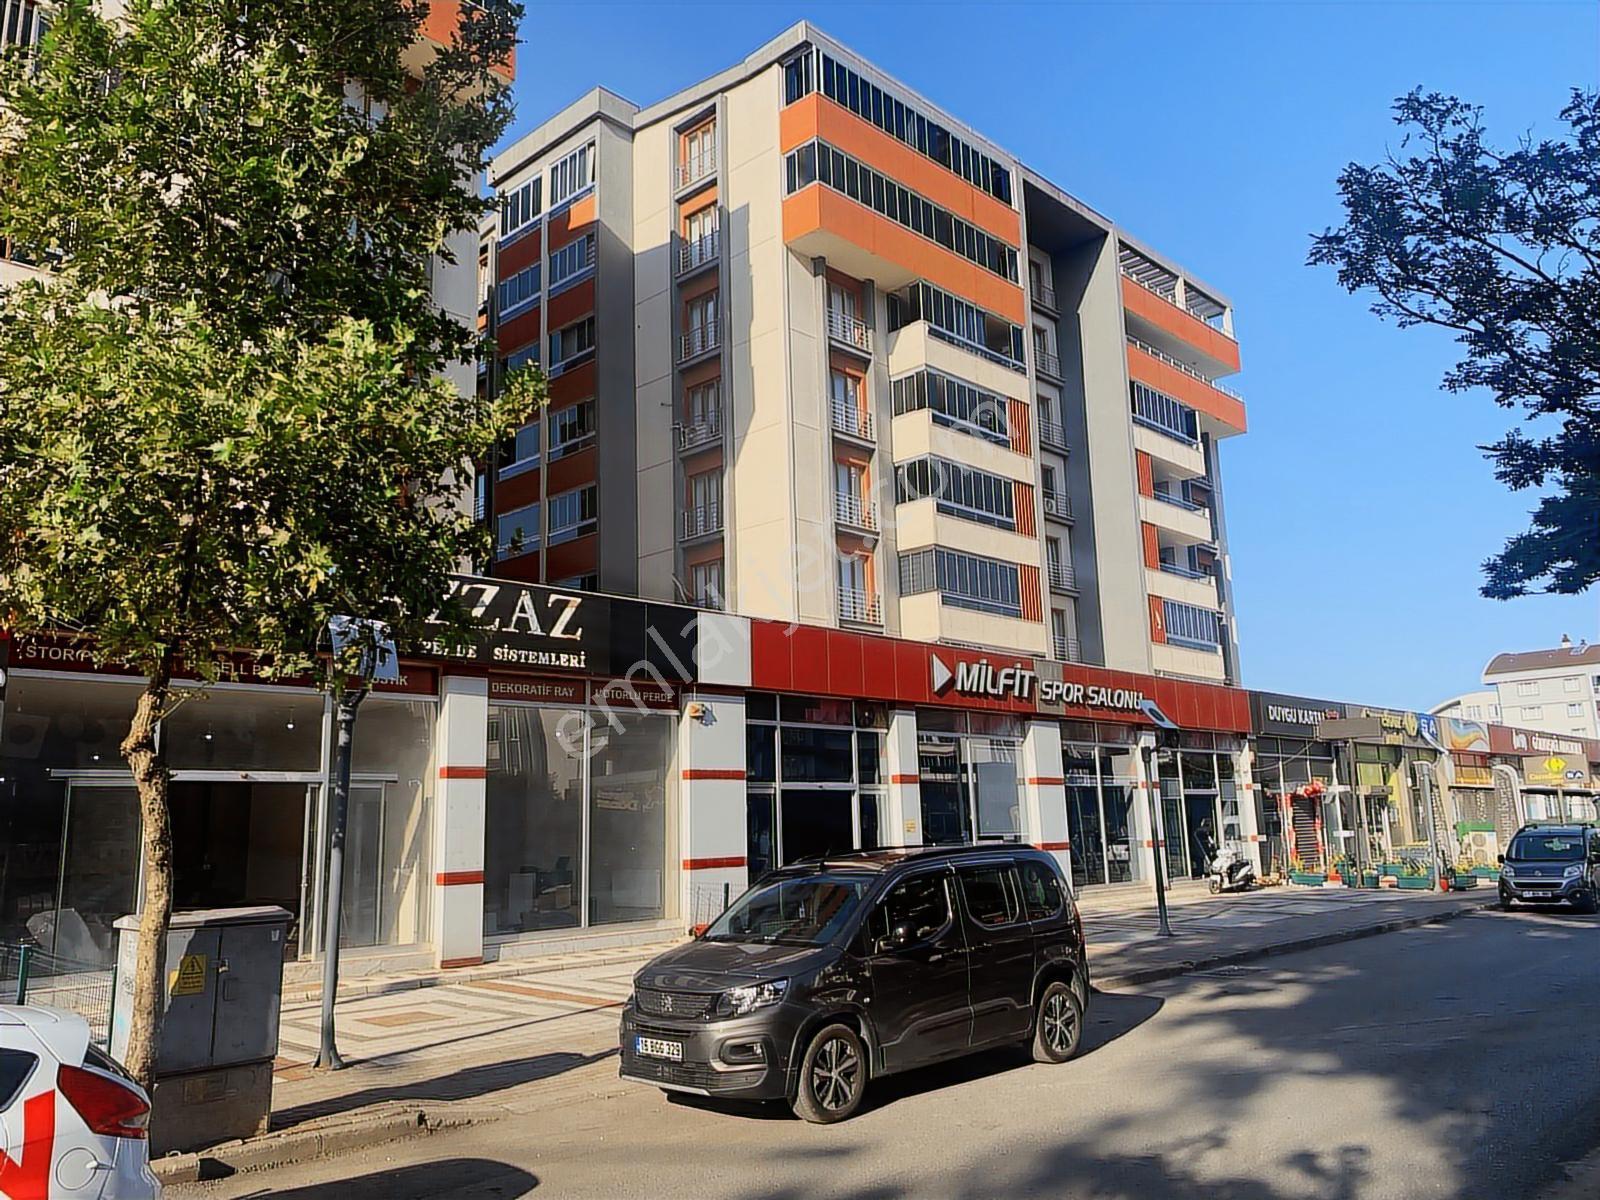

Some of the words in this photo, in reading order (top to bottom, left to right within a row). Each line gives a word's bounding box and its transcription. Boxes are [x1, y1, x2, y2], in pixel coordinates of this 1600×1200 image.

[26, 645, 74, 662] STOR
[493, 643, 586, 669] SİSTEMLERİ
[492, 682, 551, 697] DEKORATİF
[554, 686, 575, 698] RAY
[956, 658, 1034, 698] MİLFİT
[1041, 681, 1083, 702] SPOR
[1088, 686, 1144, 711] SALONU
[643, 691, 674, 703] PERDE
[1268, 704, 1297, 723] DUYGU
